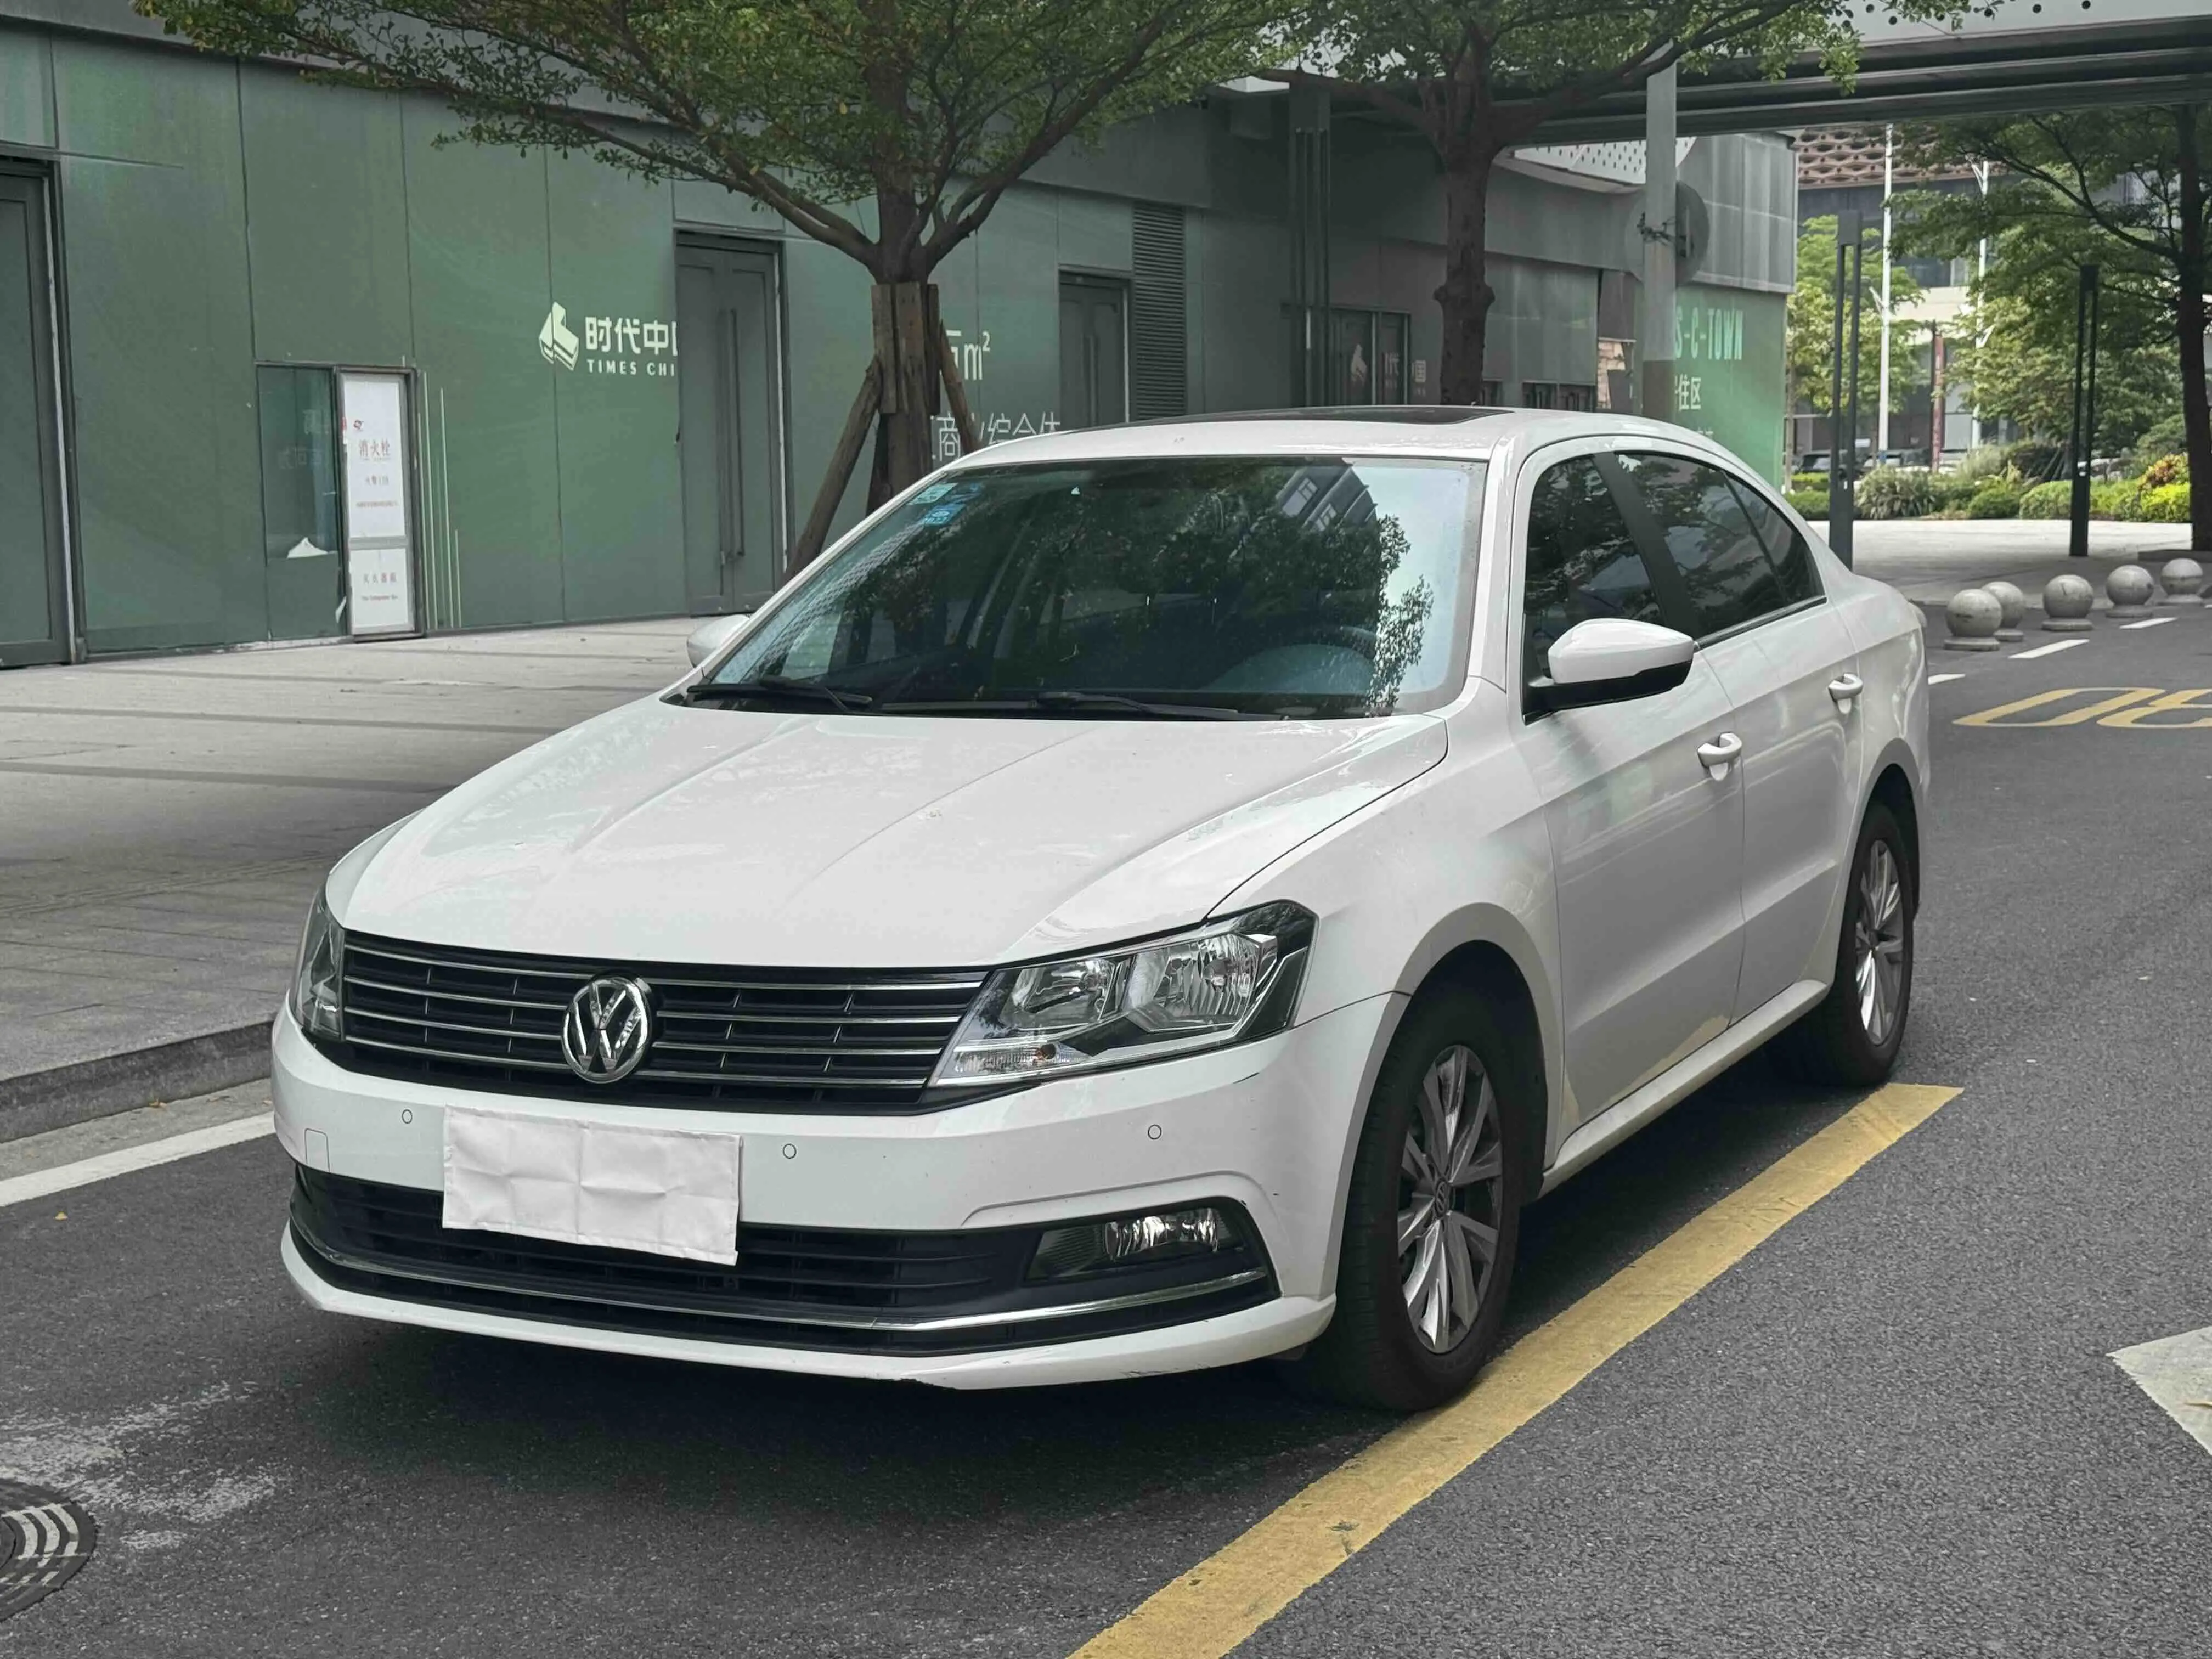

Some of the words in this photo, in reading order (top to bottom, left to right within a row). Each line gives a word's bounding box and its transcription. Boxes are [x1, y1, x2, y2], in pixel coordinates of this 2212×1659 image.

[585, 317, 678, 356] 时代中
[586, 359, 637, 375] TIMES
